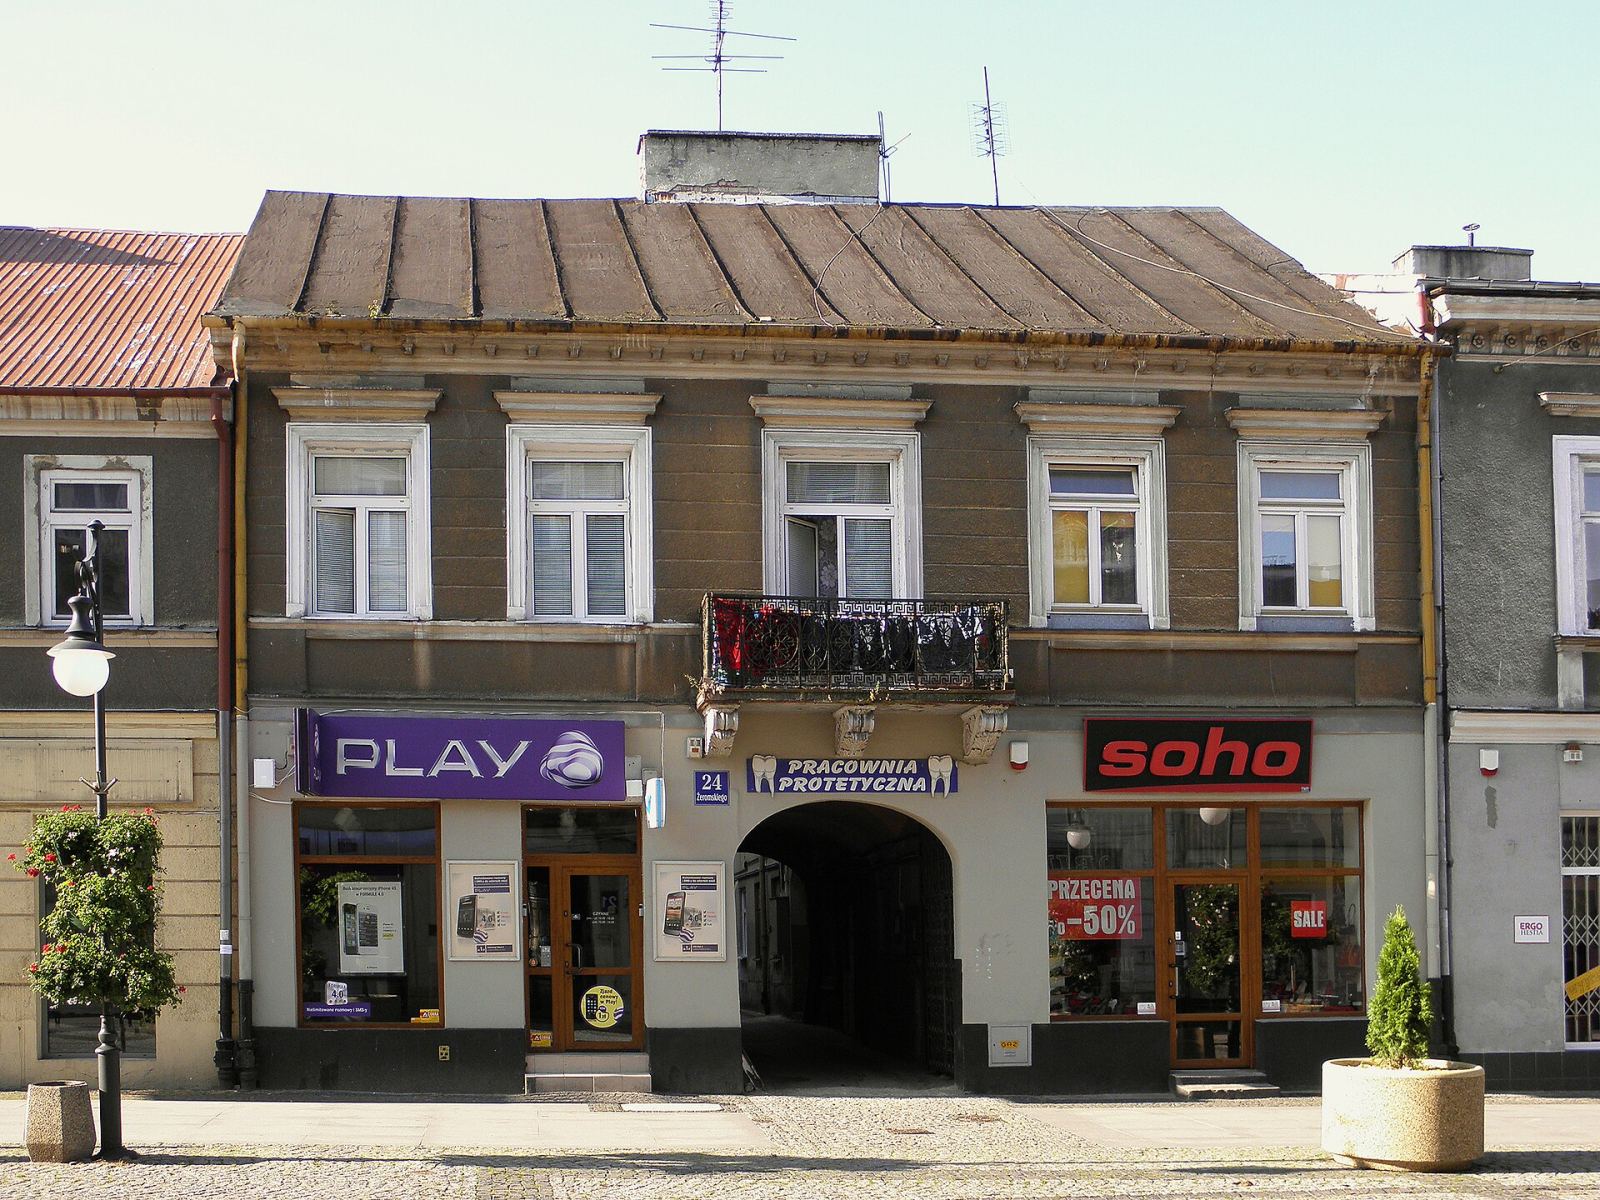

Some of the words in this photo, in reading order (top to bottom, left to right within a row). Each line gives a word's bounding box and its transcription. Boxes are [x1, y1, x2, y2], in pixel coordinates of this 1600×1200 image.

[336, 738, 533, 778] PLAY
[1099, 726, 1301, 777] soho
[788, 759, 918, 774] PRACOWNIA
[702, 773, 723, 790] 24
[778, 776, 926, 792] PROTETYCZNA
[696, 792, 728, 803] Żeromskiego
[1048, 879, 1136, 899] PRZECENA
[1066, 904, 1136, 935] -50%
[1293, 910, 1324, 928] SALE
[1519, 922, 1543, 930] ERGO
